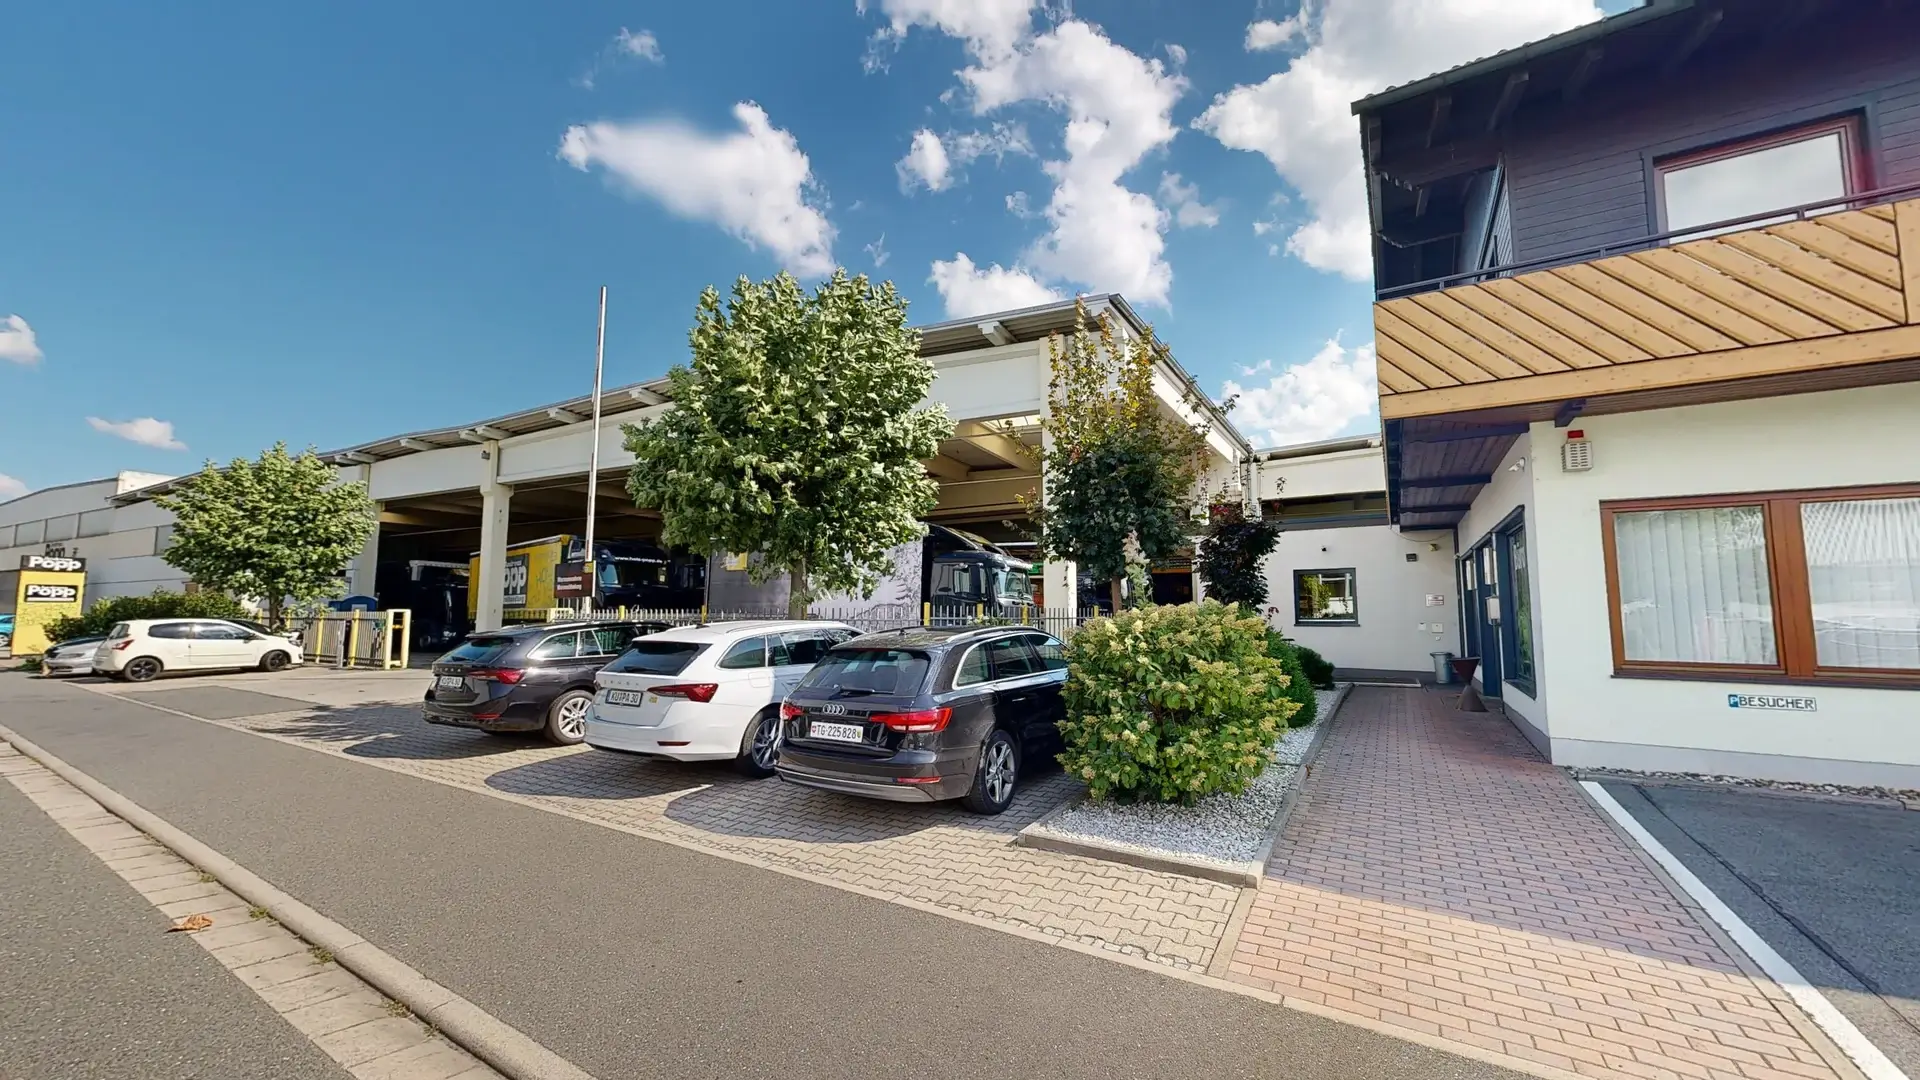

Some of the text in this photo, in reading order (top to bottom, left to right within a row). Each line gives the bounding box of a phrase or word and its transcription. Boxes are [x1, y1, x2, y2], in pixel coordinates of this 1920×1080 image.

[28, 555, 82, 571] Popp
[27, 585, 76, 598] Popp
[1739, 696, 1815, 710] BESUCHER
